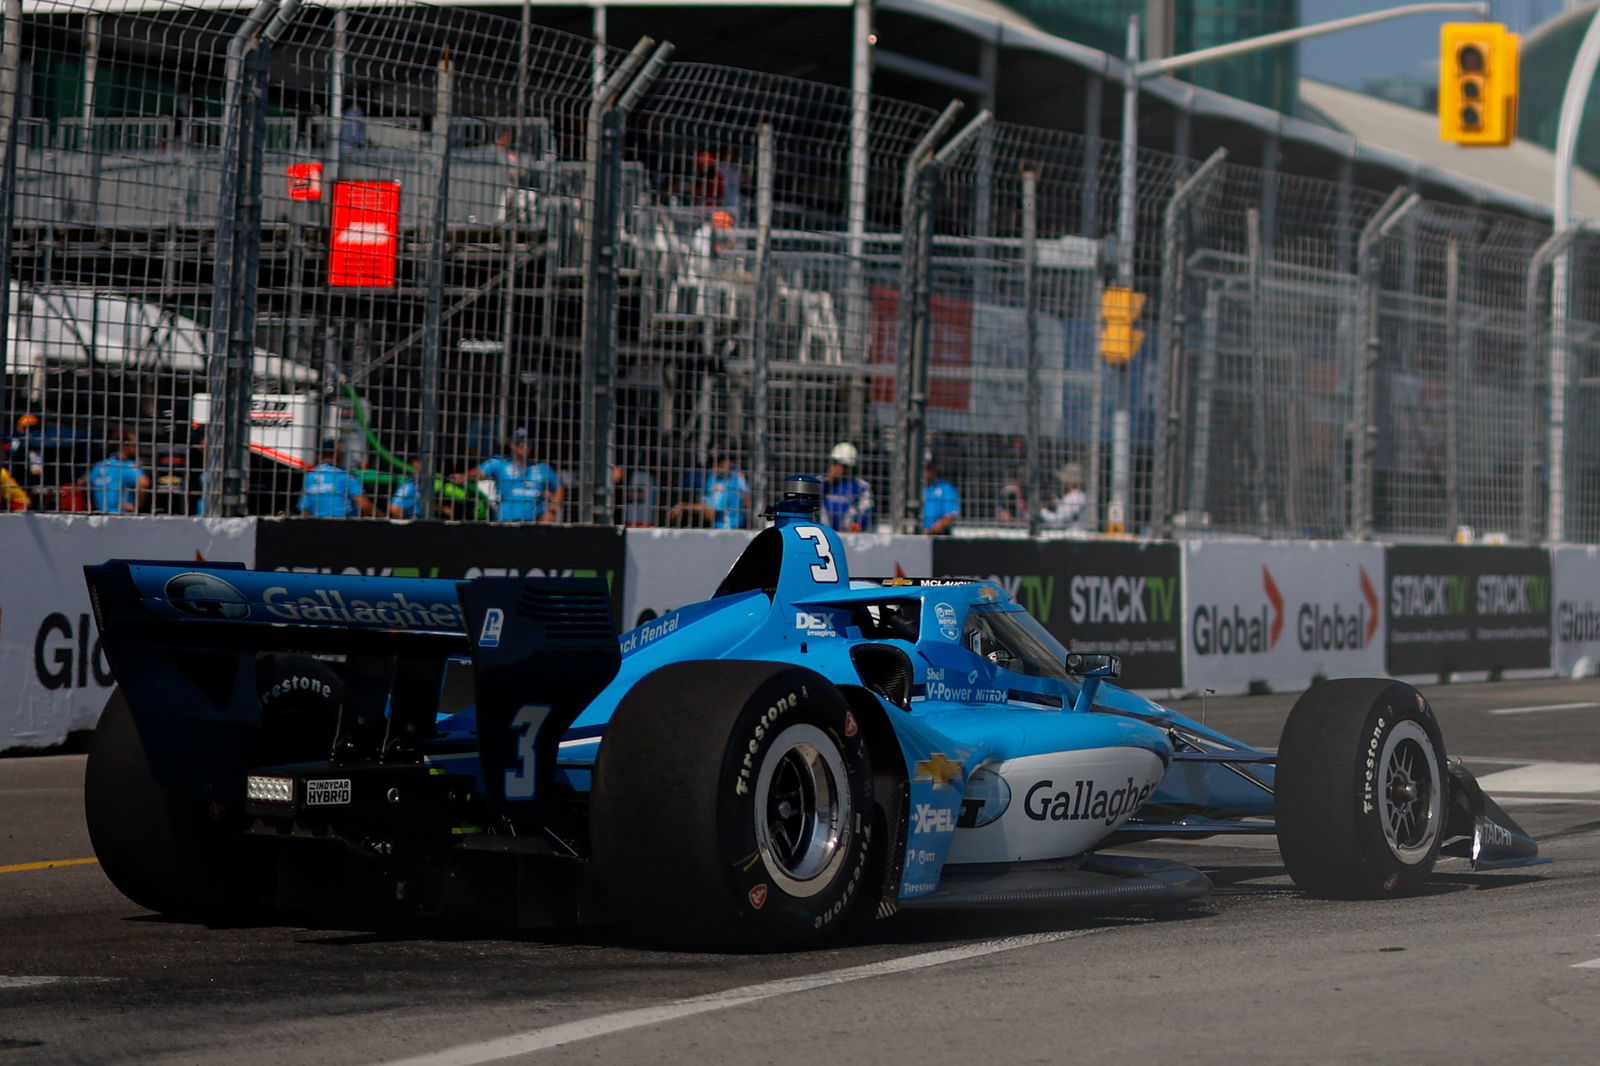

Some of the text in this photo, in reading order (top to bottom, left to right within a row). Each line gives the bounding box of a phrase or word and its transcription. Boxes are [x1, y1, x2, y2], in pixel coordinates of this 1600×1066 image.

[794, 526, 838, 583] 3
[1070, 575, 1176, 624] STACKTV
[1391, 575, 1465, 616] STACKTV
[1477, 574, 1545, 614] STACKTV
[640, 613, 680, 646] Rental
[796, 612, 835, 629] DEX
[1193, 604, 1269, 654] Global
[1298, 602, 1364, 651] Global
[260, 675, 333, 708] restone
[926, 667, 945, 681] Shell
[926, 682, 972, 701] V-Power
[506, 703, 552, 802] 3
[735, 691, 797, 797] Firestone
[316, 781, 349, 790] INDYCAR
[1363, 717, 1386, 815] Firestone
[914, 803, 955, 834] XPEL
